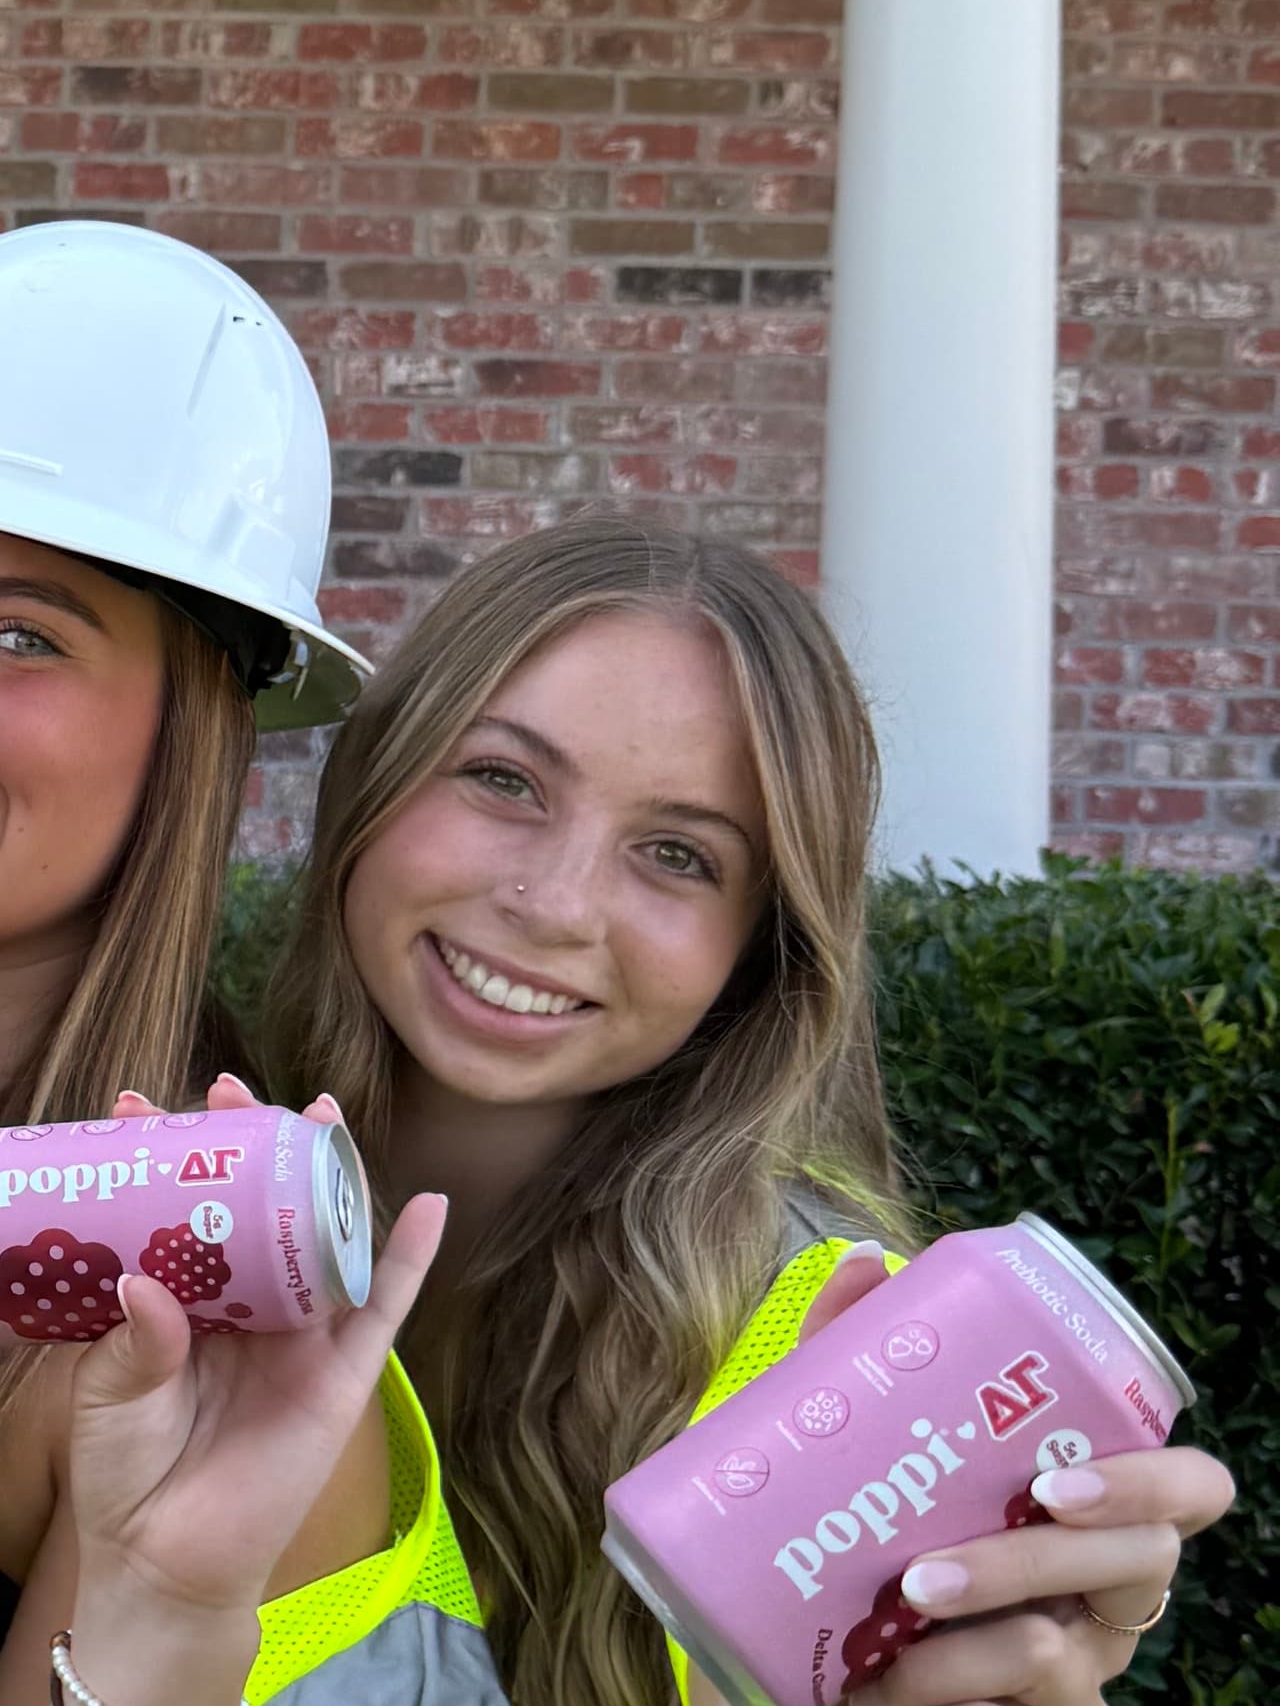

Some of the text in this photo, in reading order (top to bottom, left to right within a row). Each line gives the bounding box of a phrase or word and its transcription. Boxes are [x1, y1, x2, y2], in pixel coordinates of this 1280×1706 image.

[175, 1147, 243, 1187] ΔΓ
[274, 1147, 292, 1182] Soda
[277, 1207, 303, 1290] Raspberry
[995, 1248, 1109, 1364] Prebiotic Soda
[773, 1350, 1059, 1600] poppi ΔΓ
[813, 1629, 833, 1673] Delta
